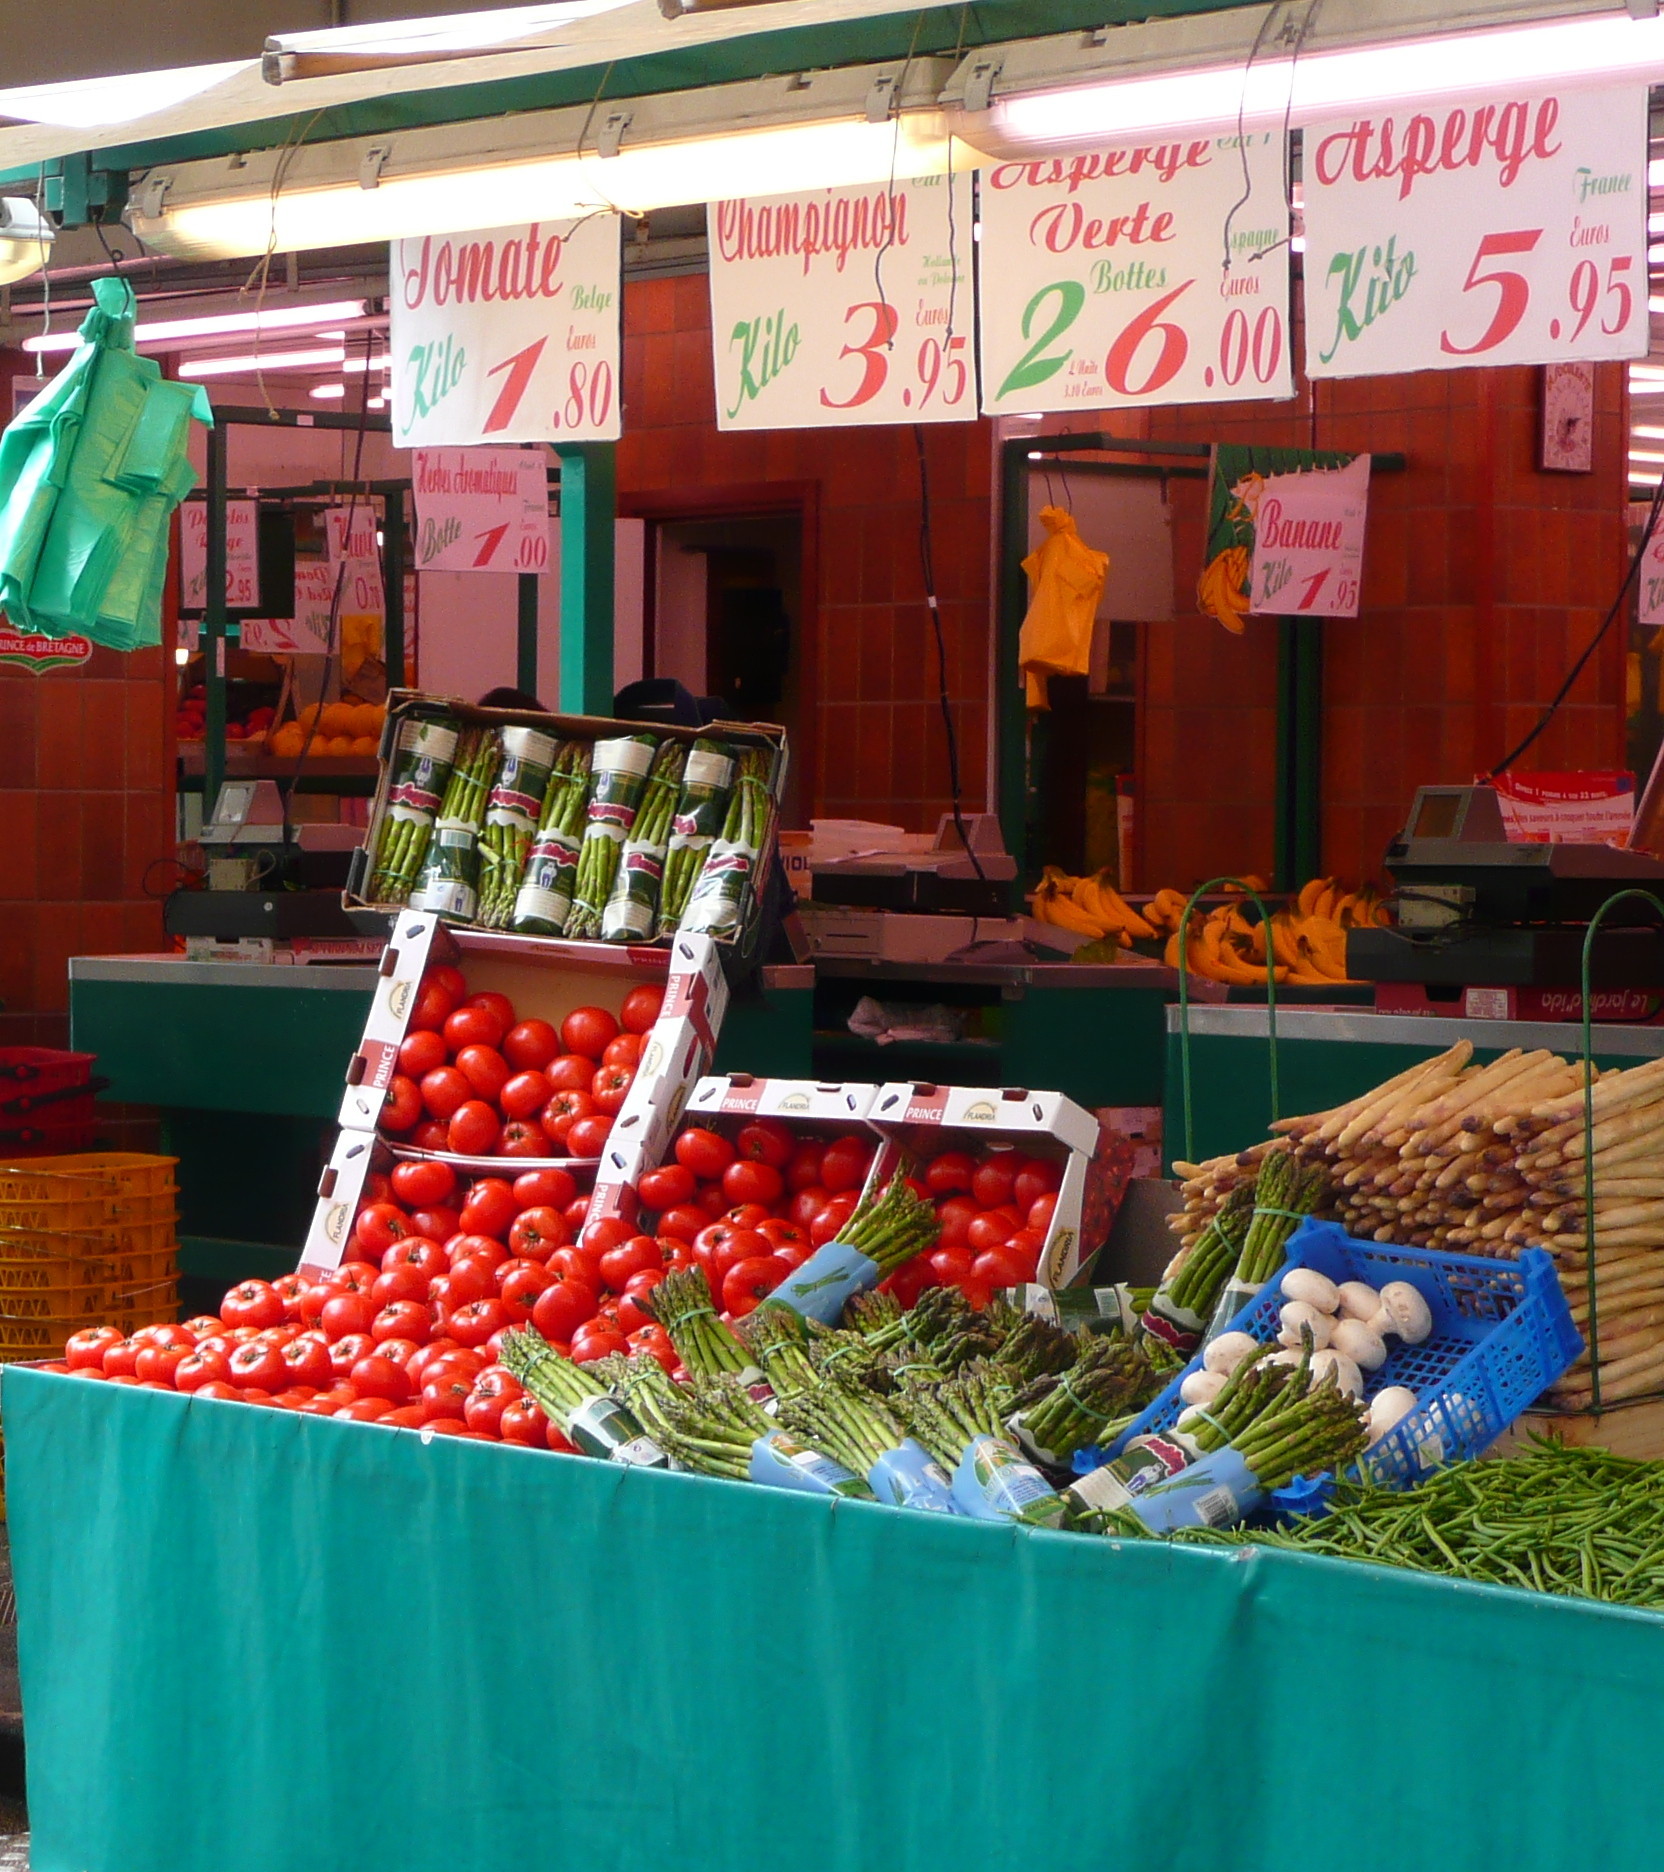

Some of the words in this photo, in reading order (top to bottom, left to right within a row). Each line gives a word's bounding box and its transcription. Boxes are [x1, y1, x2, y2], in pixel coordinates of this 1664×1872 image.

[1315, 97, 1563, 201] Asperge
[1573, 167, 1633, 204] France
[717, 188, 910, 277] Champignon
[1029, 202, 1177, 254] Verte
[1570, 216, 1610, 248] Euros
[569, 284, 613, 314] Belge
[1090, 259, 1168, 294] Bottes
[1320, 234, 1418, 364] Kilo
[566, 324, 597, 351] Euros
[994, 280, 1086, 401] 2
[402, 332, 467, 436] Kilo
[727, 307, 802, 419] Kilo
[421, 516, 462, 565] Botte
[1261, 498, 1344, 551] Banane
[1254, 557, 1293, 609] Kilo
[36, 640, 86, 654] BRETAGNE
[666, 974, 681, 1018] PRINCE
[1584, 989, 1630, 1013] jardi
[372, 1043, 396, 1090] PRINCE
[721, 1097, 759, 1110] PRINCE
[905, 1107, 943, 1121] PRINCE
[966, 1111, 996, 1121] FLANDRIA
[589, 1183, 608, 1226] PRINC
[1052, 1230, 1075, 1283] FLANDRIA
